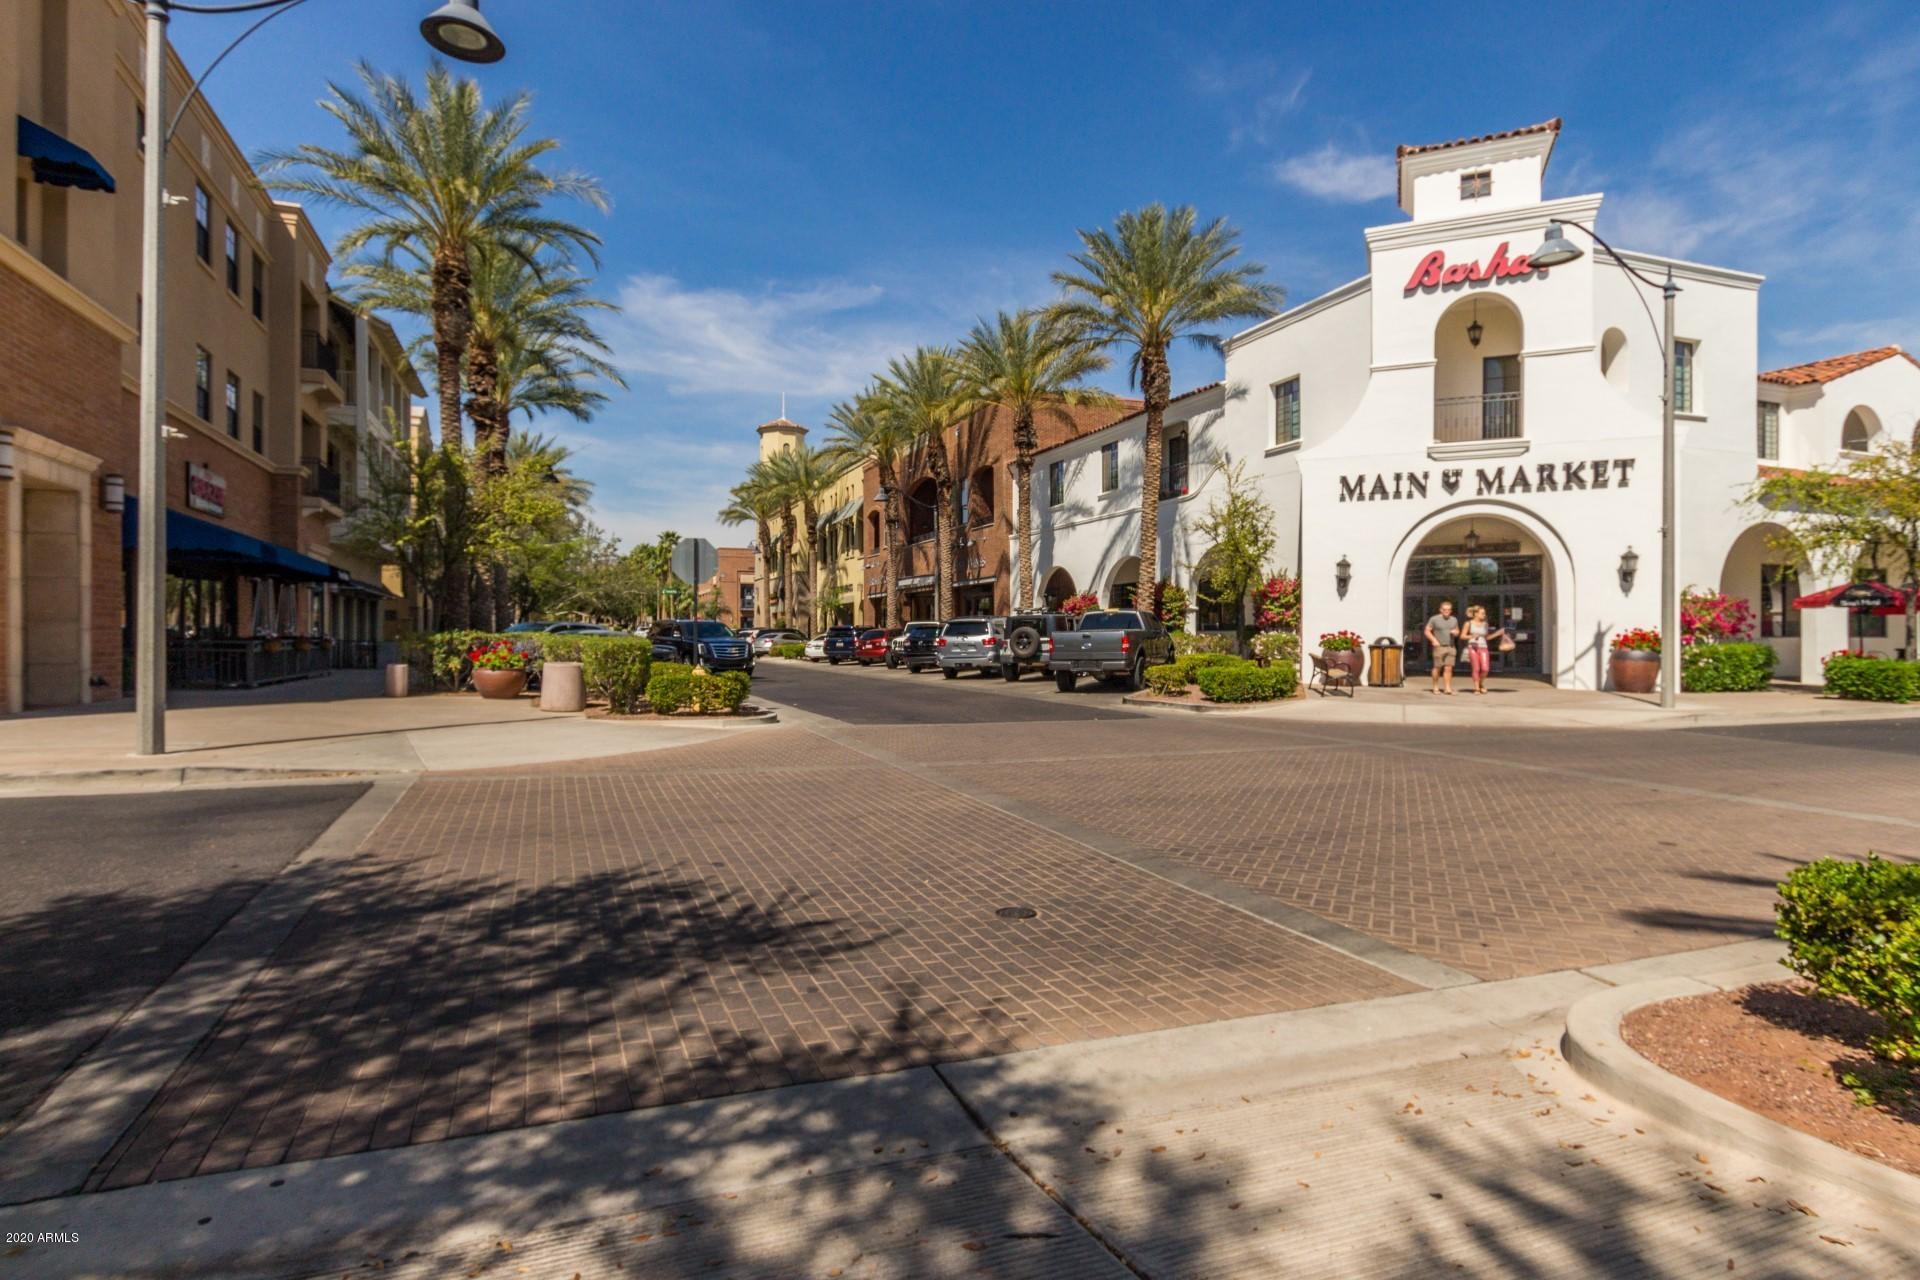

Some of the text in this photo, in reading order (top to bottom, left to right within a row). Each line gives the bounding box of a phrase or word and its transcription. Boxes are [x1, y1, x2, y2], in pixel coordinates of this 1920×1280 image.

[1404, 241, 1550, 292] Basha
[1340, 471, 1429, 501] MAIN
[1476, 458, 1635, 496] MARKET
